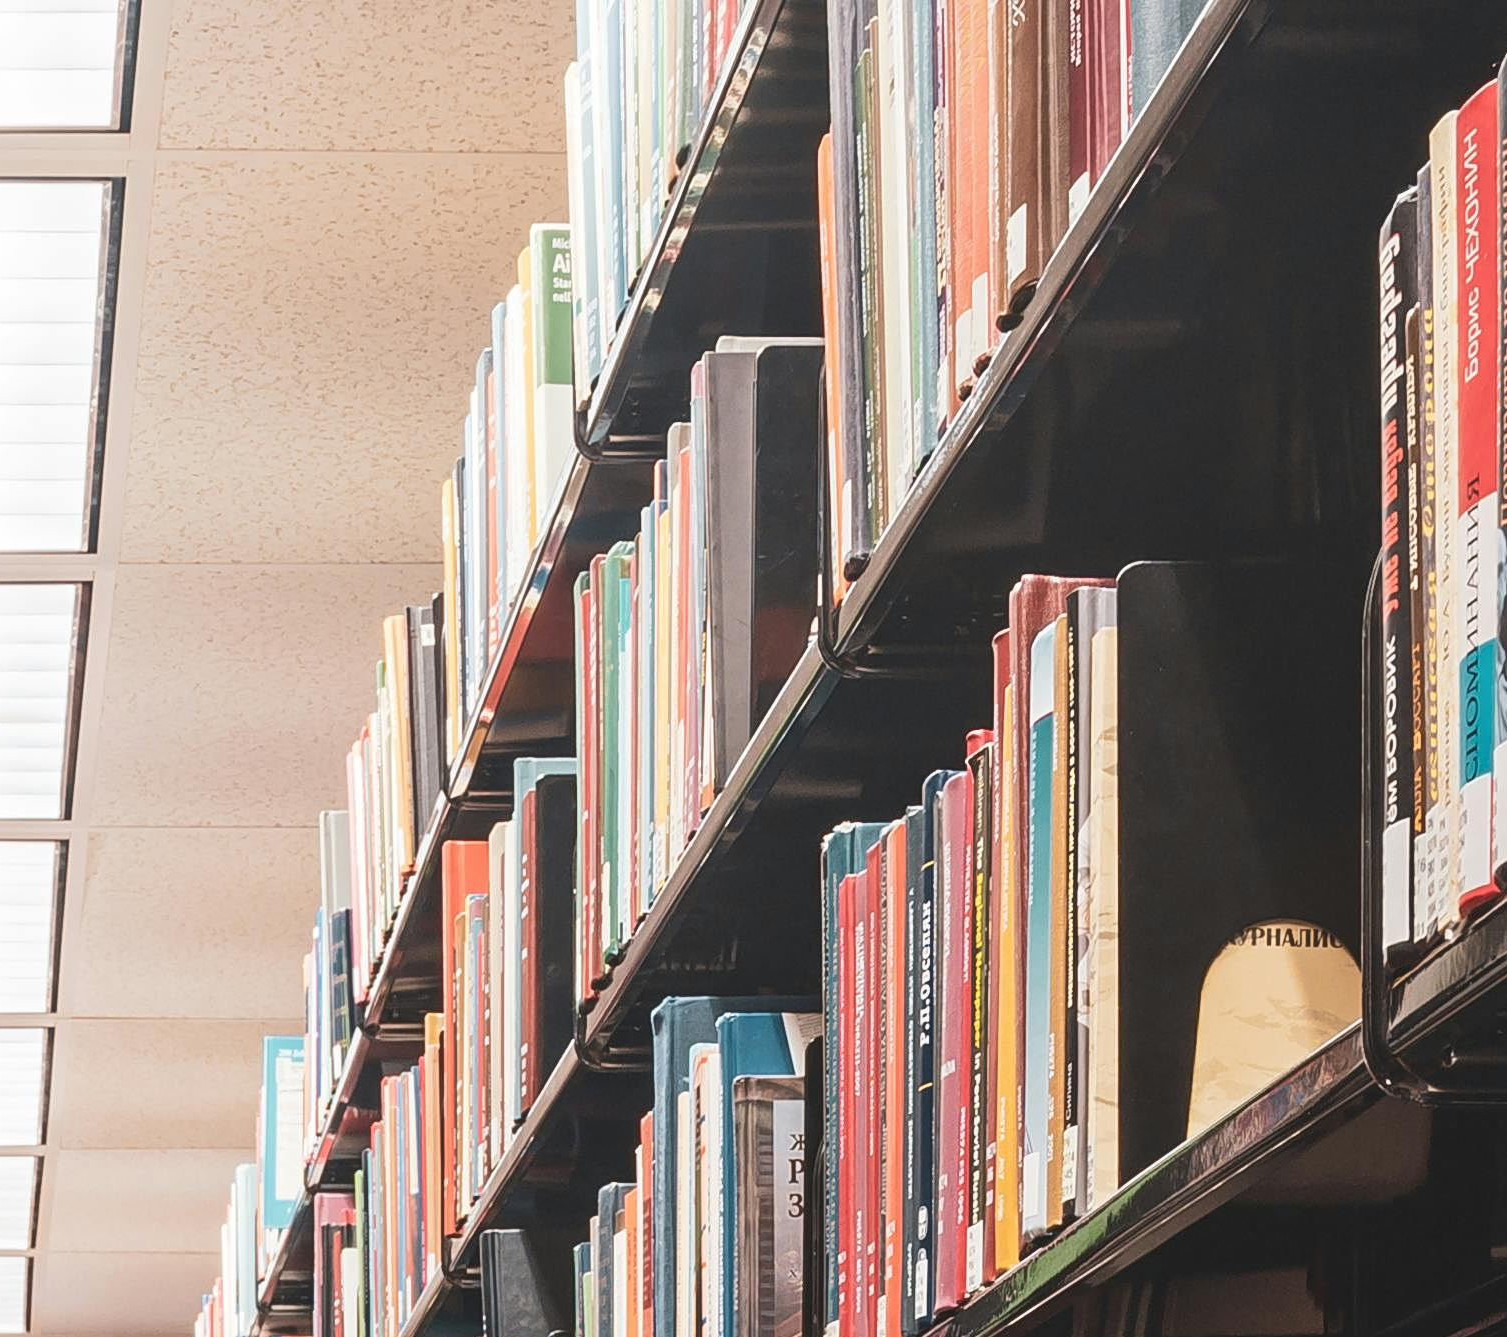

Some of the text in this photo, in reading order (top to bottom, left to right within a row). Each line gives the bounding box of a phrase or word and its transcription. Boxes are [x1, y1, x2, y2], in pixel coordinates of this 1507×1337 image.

[1462, 128, 1482, 384] Борис ЧЕХОНИН
[1385, 634, 1398, 778] БОРОВИК
